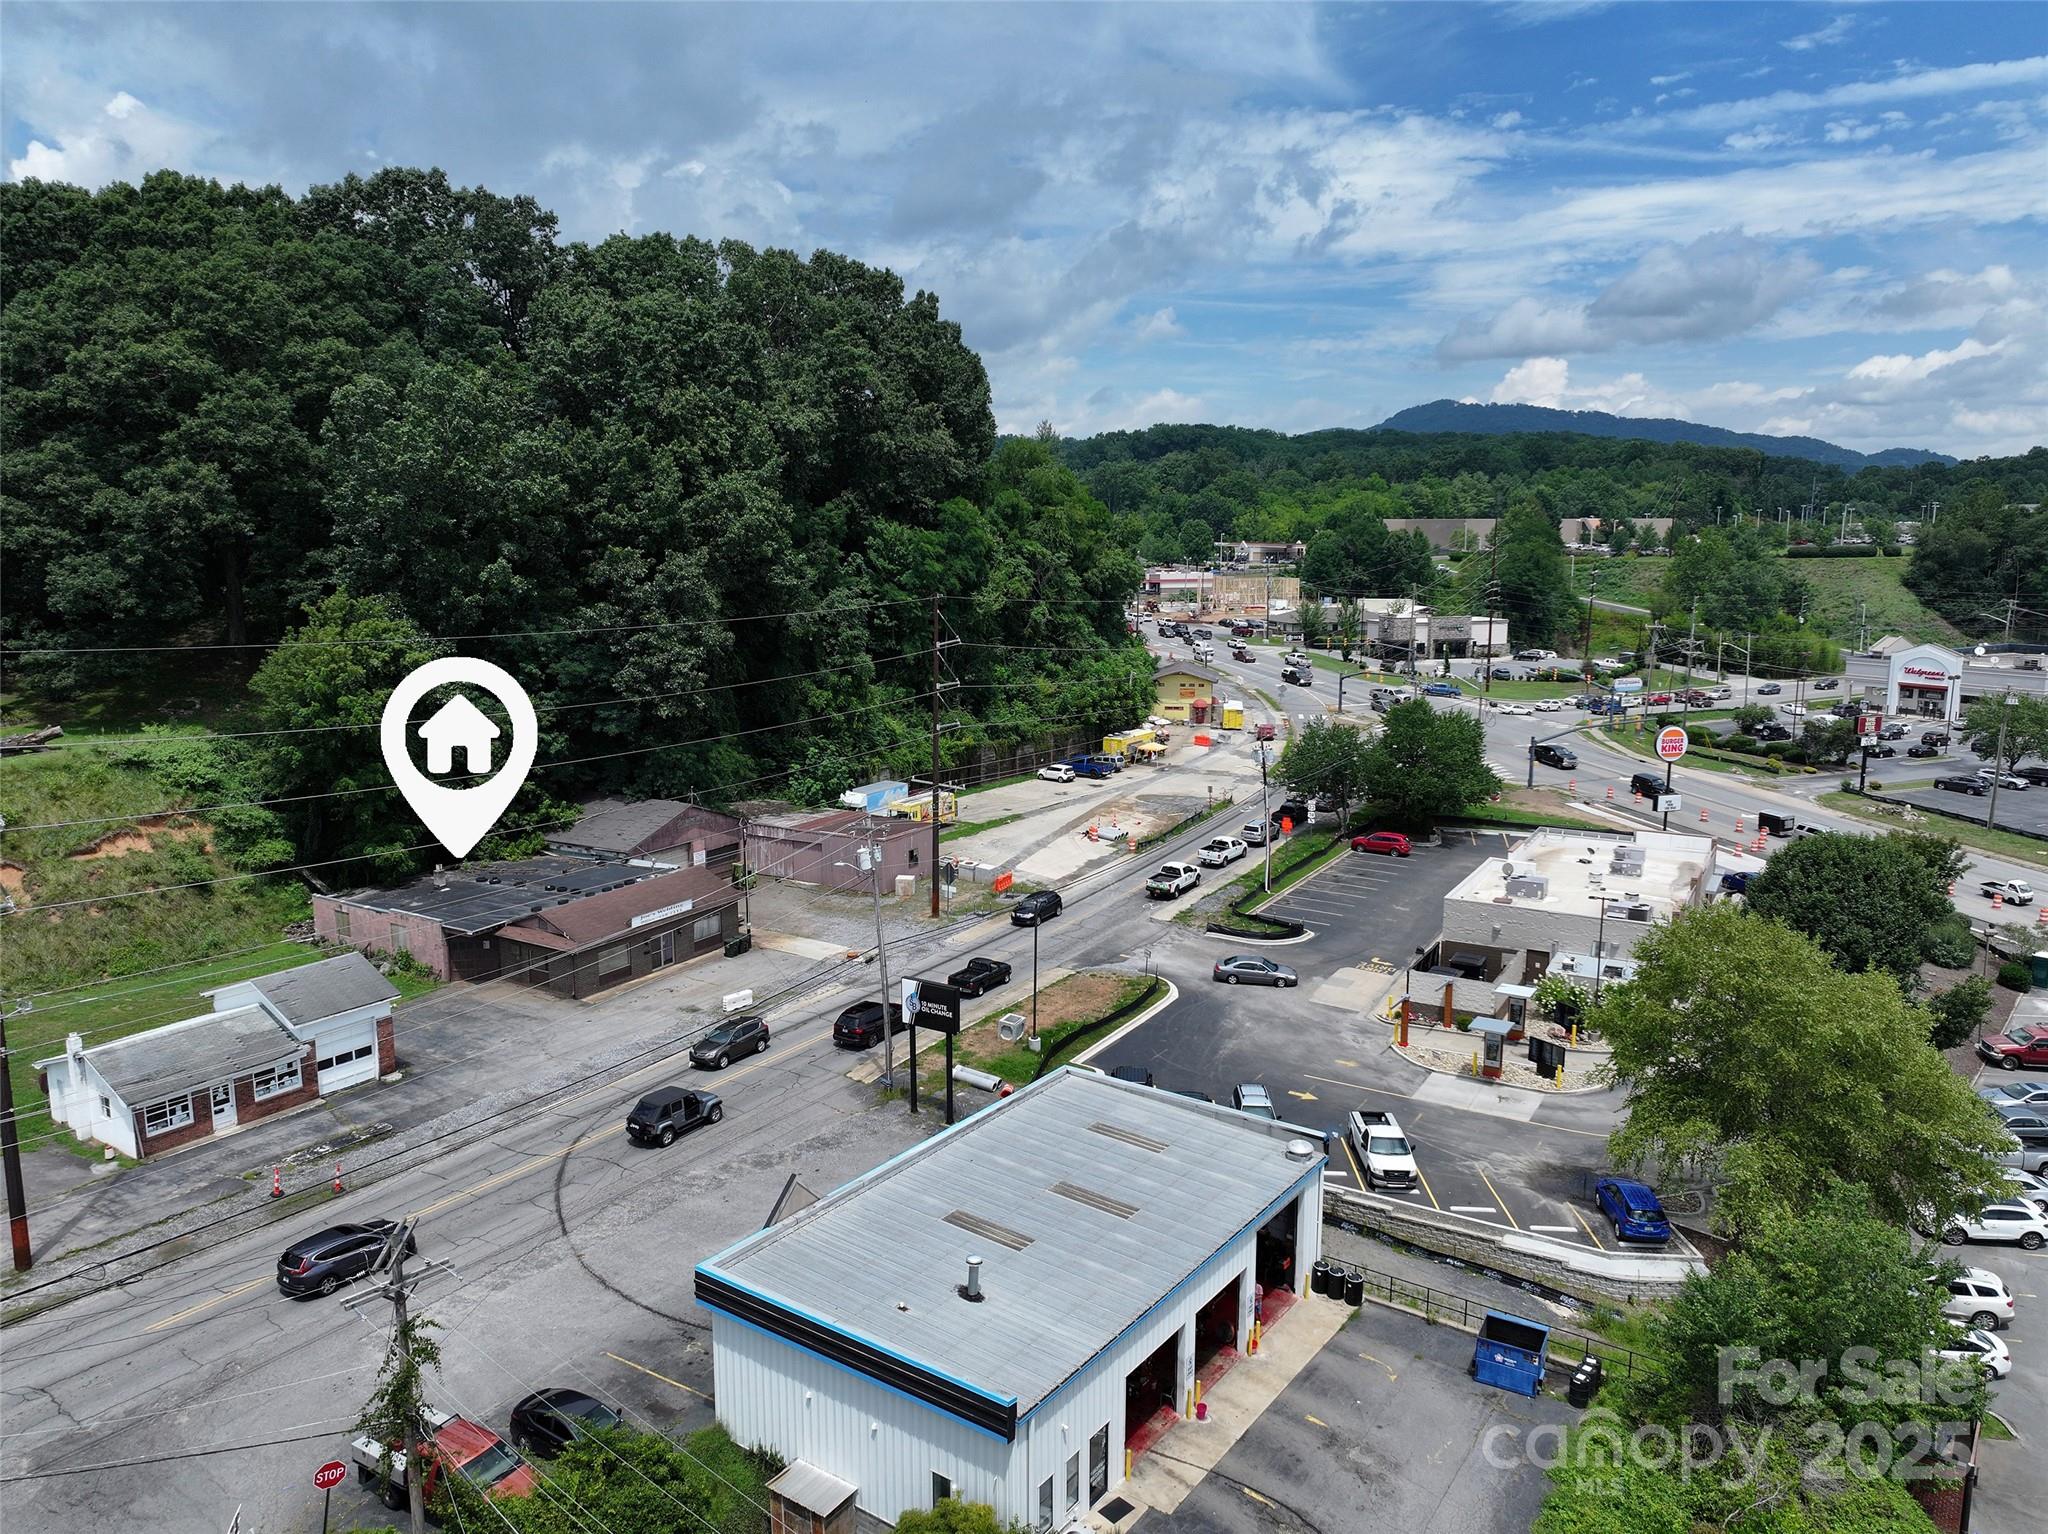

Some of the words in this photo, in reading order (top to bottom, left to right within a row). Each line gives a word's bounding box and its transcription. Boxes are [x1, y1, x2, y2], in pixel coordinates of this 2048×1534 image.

[1904, 666, 1945, 677] Walgreens
[1661, 744, 1684, 753] KING
[927, 1002, 947, 1011] MINUTE
[930, 1008, 953, 1018] CHANGE
[316, 1467, 344, 1484] STOP
